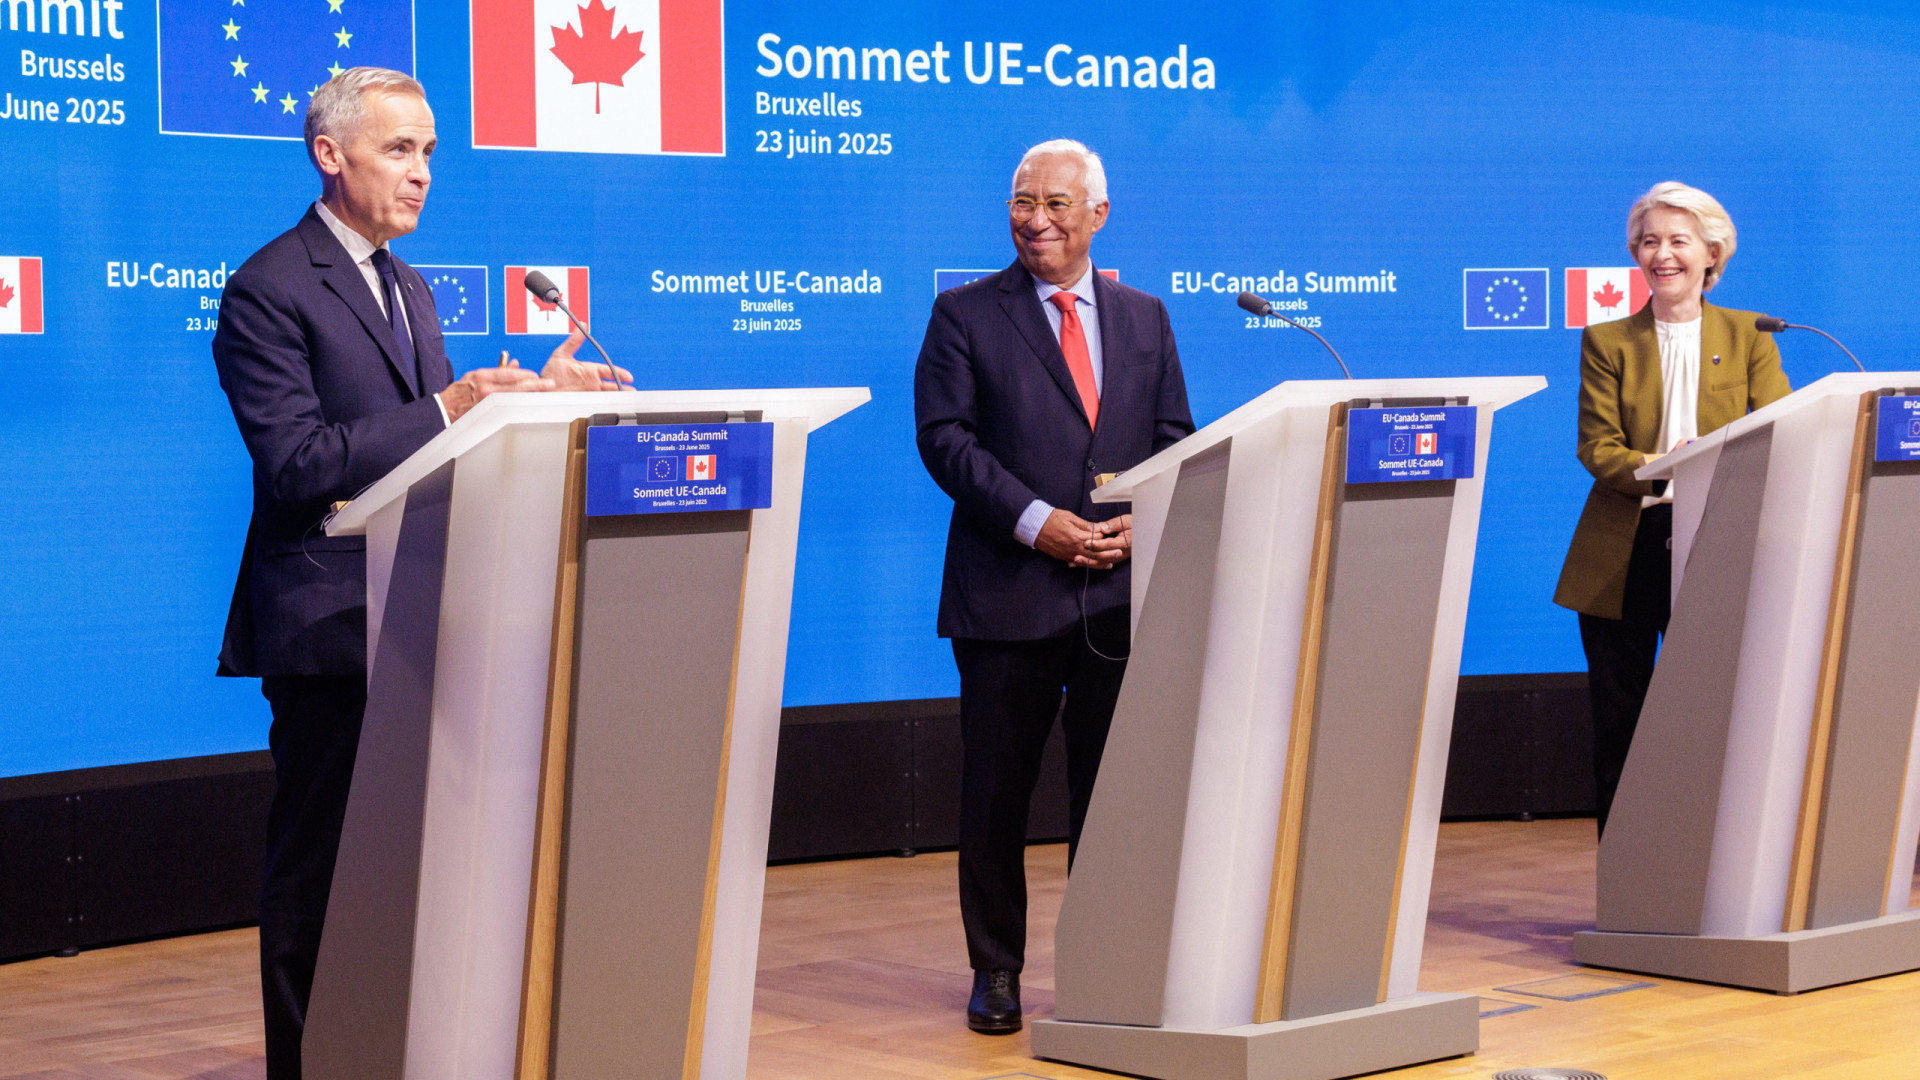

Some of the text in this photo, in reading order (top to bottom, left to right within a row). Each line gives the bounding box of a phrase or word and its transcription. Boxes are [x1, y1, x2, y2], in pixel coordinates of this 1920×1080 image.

[21, 49, 125, 83] Brussels
[756, 32, 1216, 90] Sommet UE-Canada
[0, 92, 126, 126] June 2025
[756, 91, 862, 118] Bruxelles
[756, 129, 893, 159] 23 juin 2025
[107, 261, 237, 289] EU-Canad
[651, 269, 882, 294] Sommet UE-Canada
[1172, 270, 1397, 294] EU-Canada Summit
[740, 300, 794, 312] Bruxelles
[186, 318, 201, 331] 23
[733, 318, 802, 334] 23 juin 2025
[1245, 317, 1260, 329] 23
[1382, 412, 1446, 423] EU-Canada Summit
[637, 429, 728, 443] EU-Canada Summit
[1378, 457, 1444, 469] Sommet UE-Canada
[633, 484, 727, 499] Sommet UE-Canada
